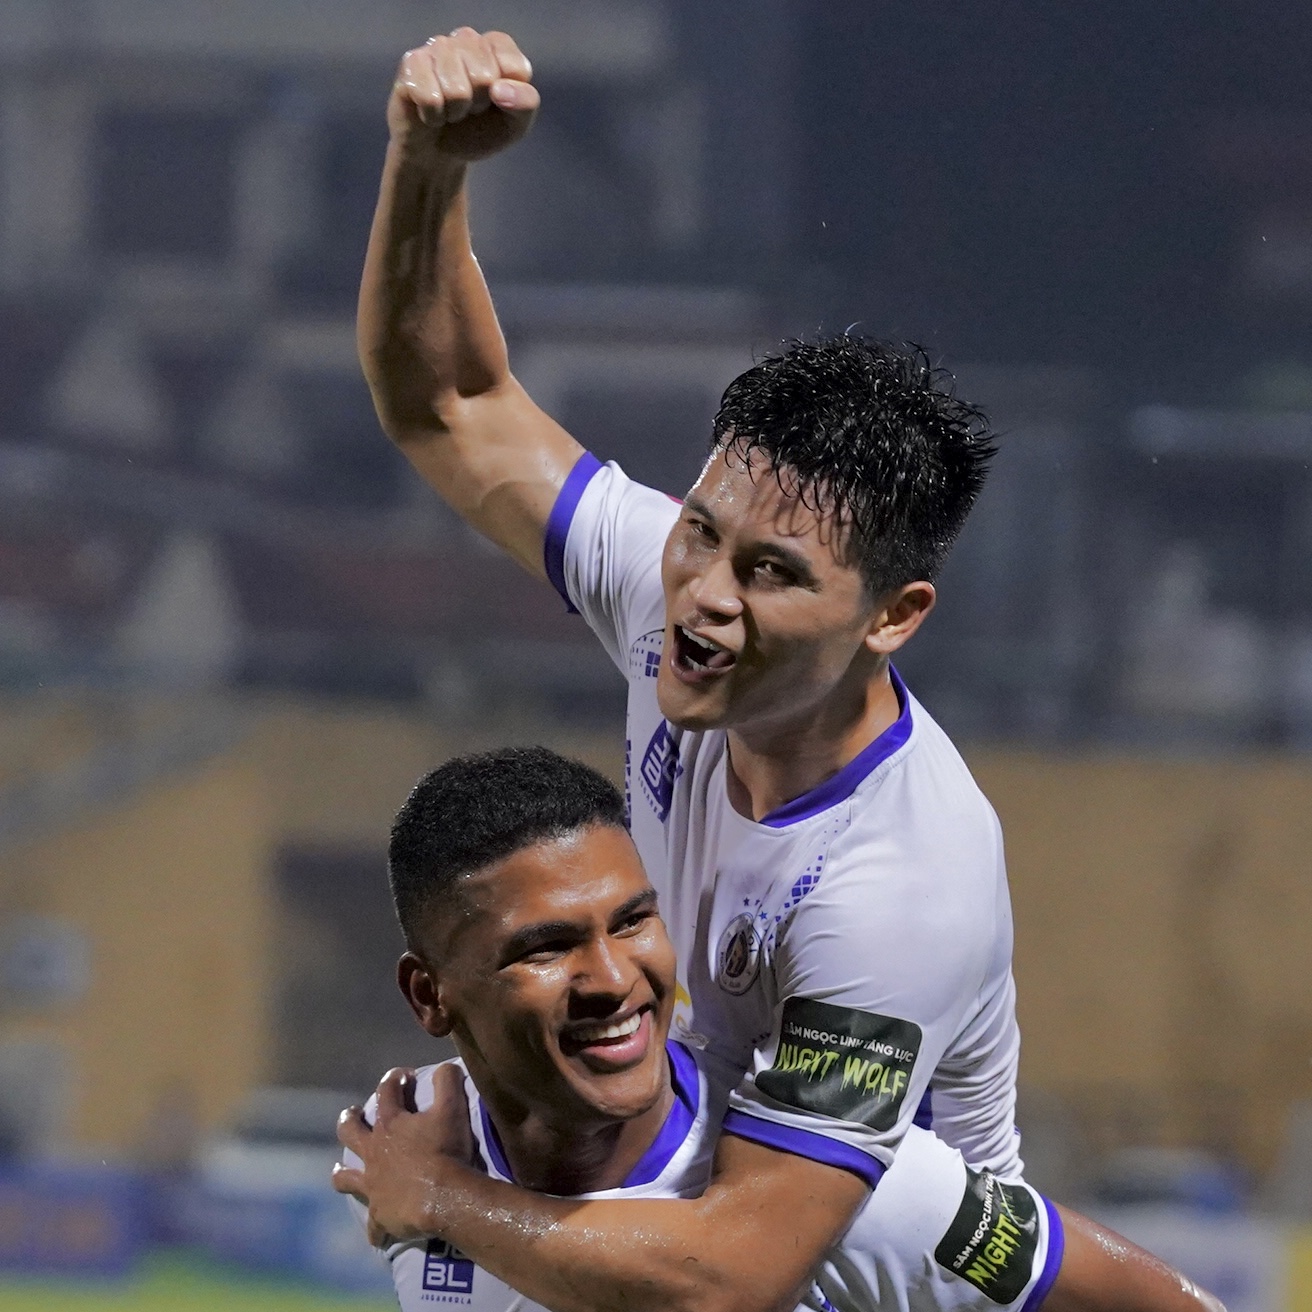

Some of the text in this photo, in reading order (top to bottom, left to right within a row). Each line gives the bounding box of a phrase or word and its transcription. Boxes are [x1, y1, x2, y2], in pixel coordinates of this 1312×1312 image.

[803, 1028, 838, 1045] NGỌC
[775, 1042, 907, 1103] NIGHT WOLF
[969, 1212, 992, 1248] NGỌC
[965, 1212, 1022, 1289] NIGHT
[426, 1262, 468, 1288] BL
